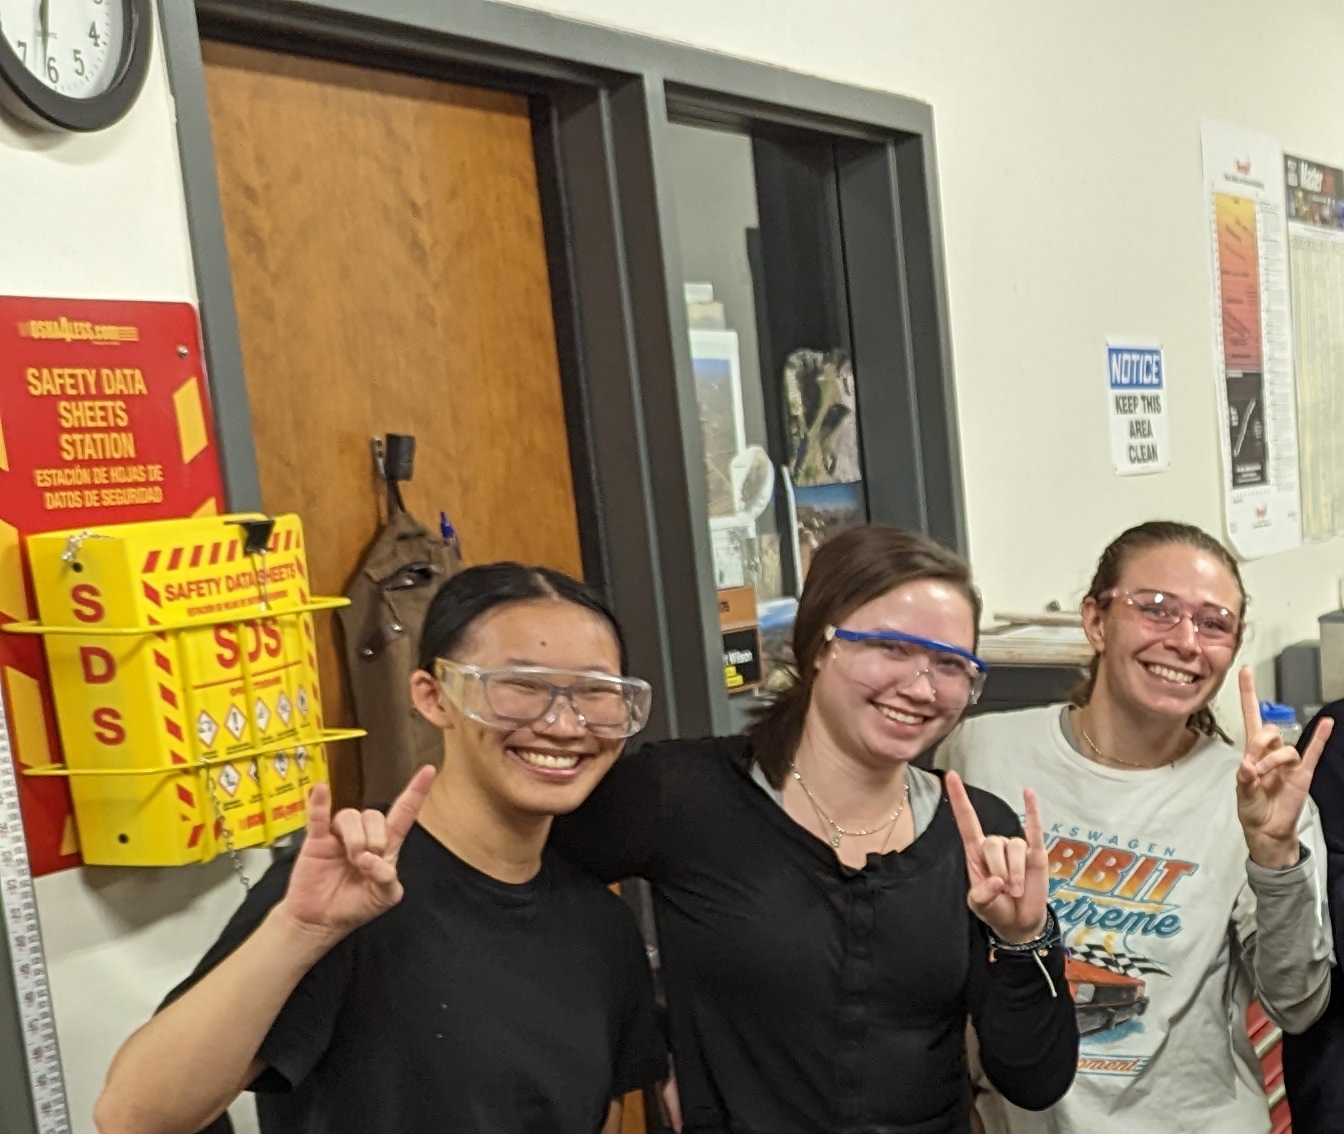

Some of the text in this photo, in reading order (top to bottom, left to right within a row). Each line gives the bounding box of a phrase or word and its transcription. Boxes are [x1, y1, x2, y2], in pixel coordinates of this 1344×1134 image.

[88, 21, 100, 47] 4
[47, 56, 59, 84] 6
[73, 49, 85, 76] 5
[26, 367, 148, 396] SAFETY DATA
[1111, 352, 1160, 385] NOTICE
[58, 401, 129, 428] SHEETS
[1115, 395, 1162, 415] KEEP THIS
[1129, 419, 1154, 439] AREA
[60, 432, 136, 461] STATION
[1128, 443, 1159, 464] CLEAN
[35, 464, 164, 487] ESTACIÓN DE HOJAS DE
[45, 486, 163, 510] DATOS DE SEGURIDAD
[165, 562, 297, 602] SAFETY DATA SHEETS
[213, 617, 282, 669] SDS
[1050, 822, 1177, 857] KSWAGEN
[1044, 836, 1199, 903] BBIT
[1050, 894, 1182, 938] treme
